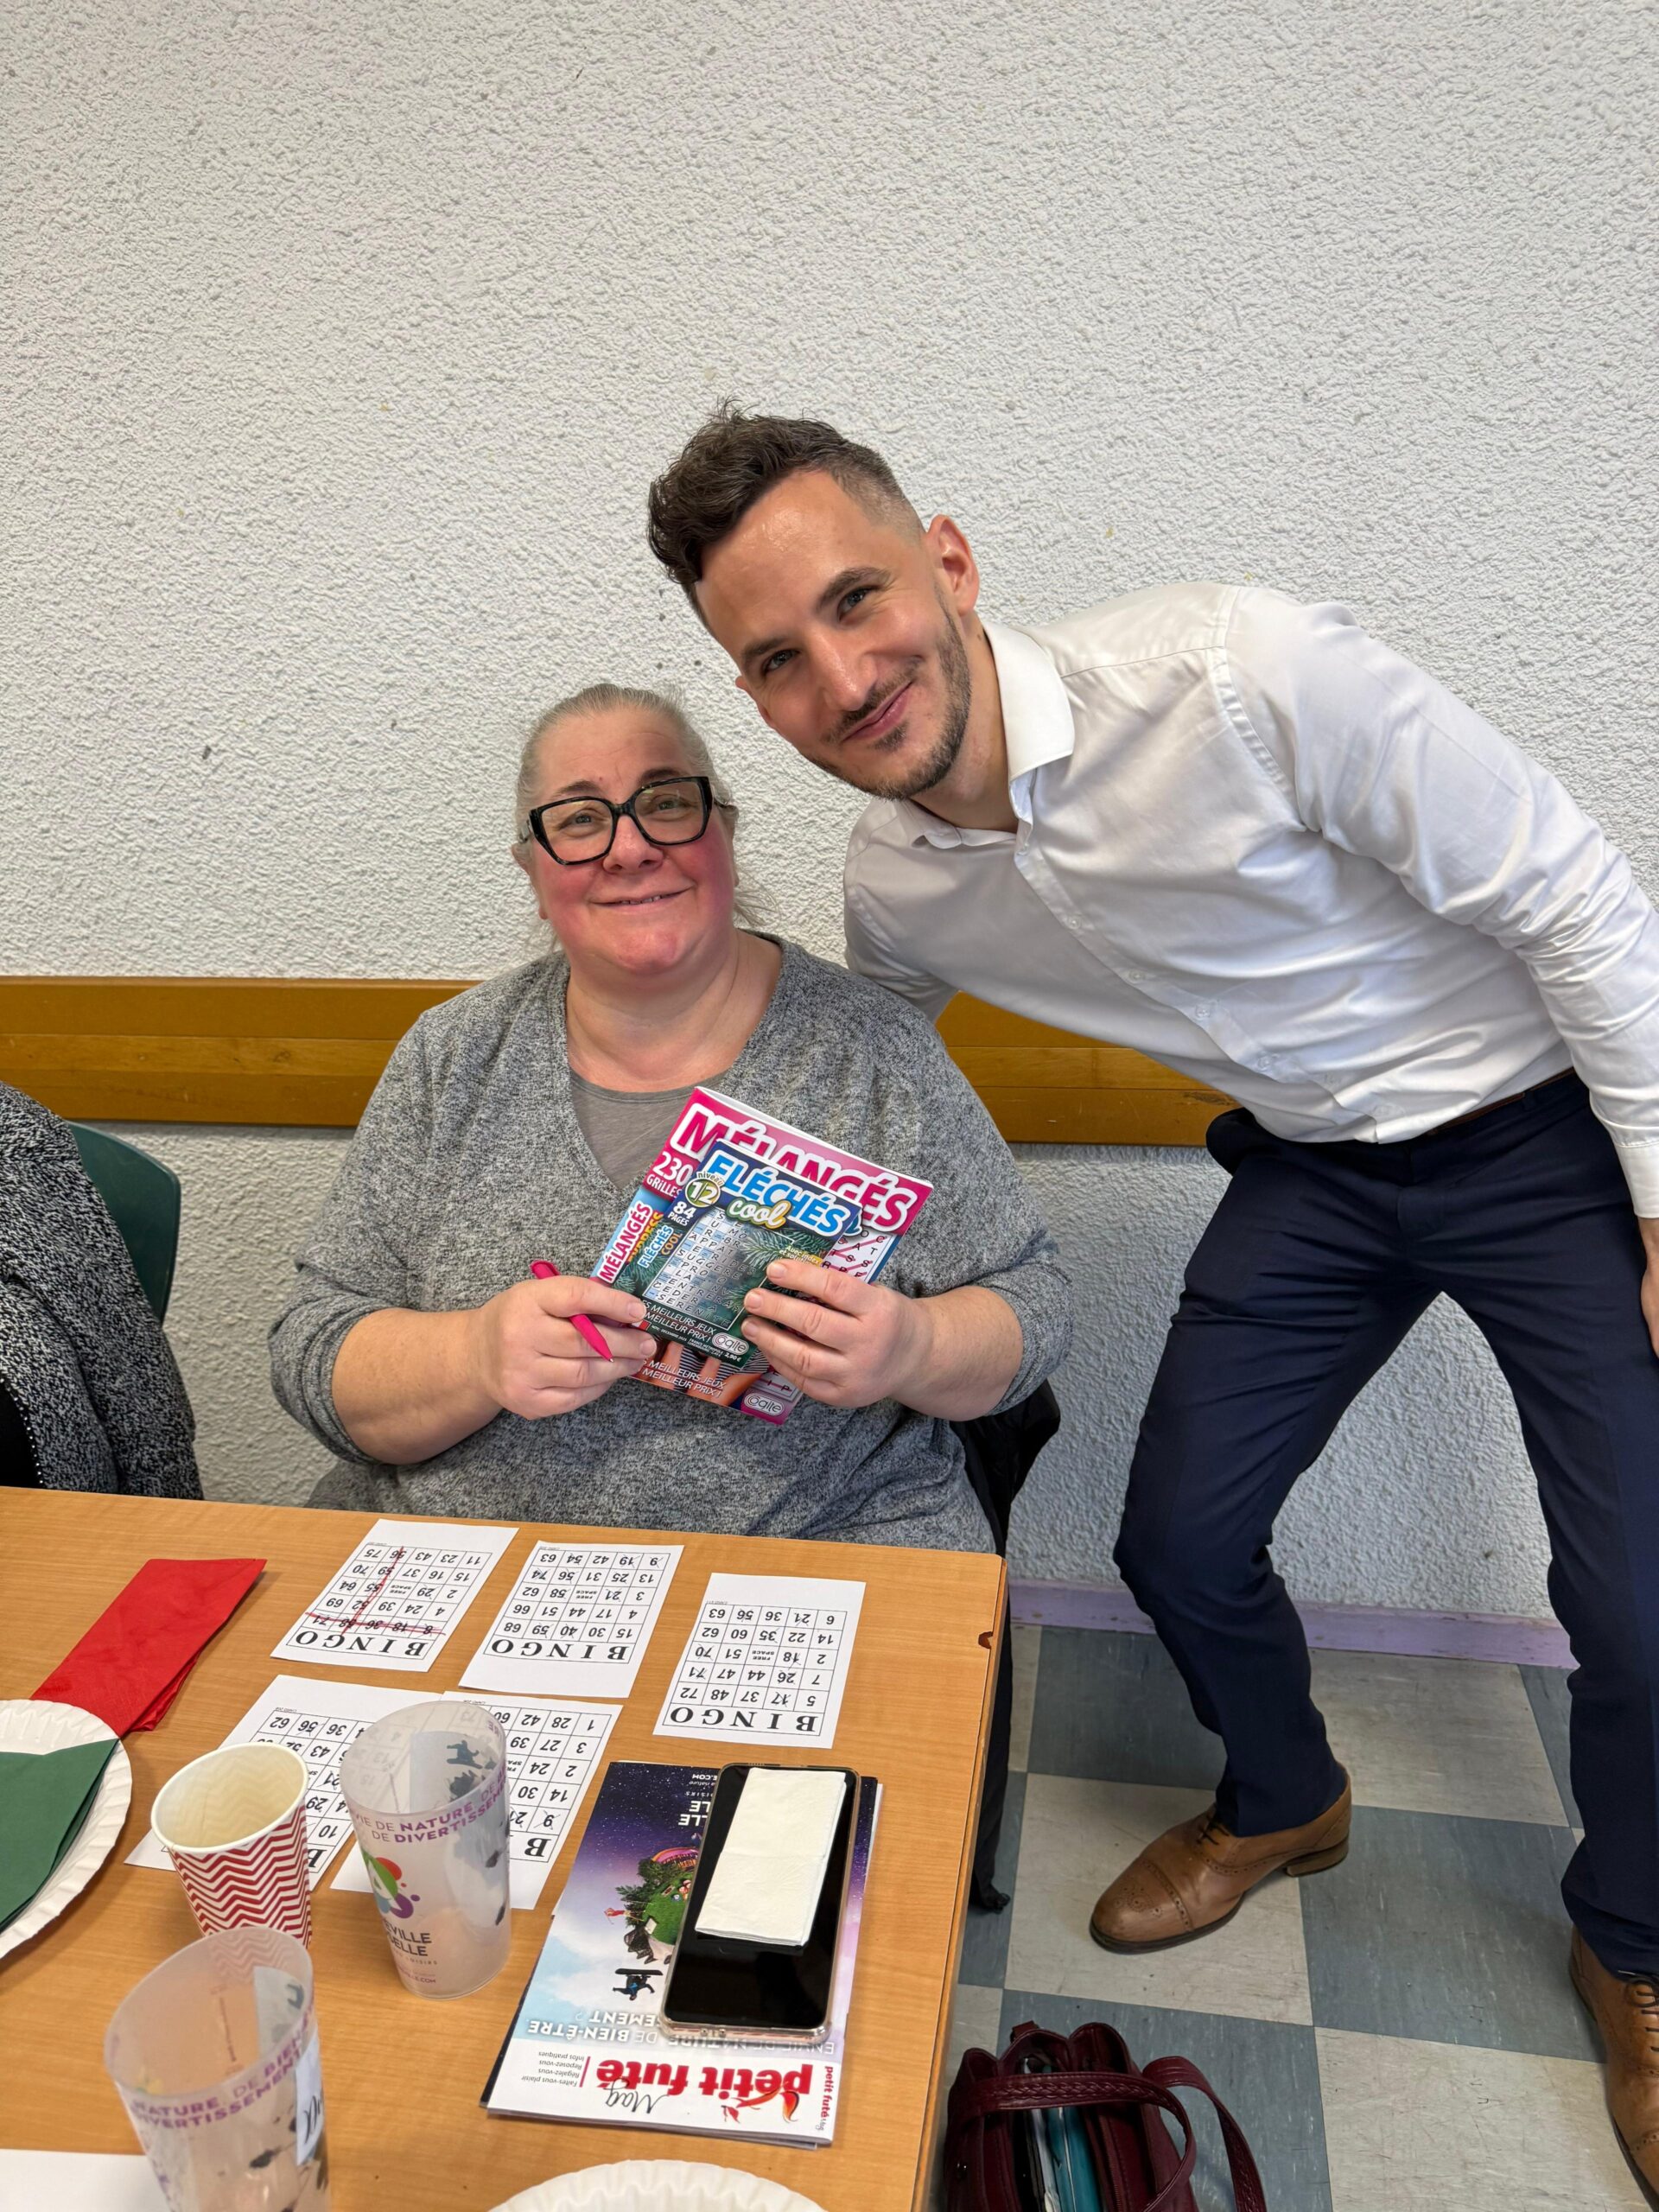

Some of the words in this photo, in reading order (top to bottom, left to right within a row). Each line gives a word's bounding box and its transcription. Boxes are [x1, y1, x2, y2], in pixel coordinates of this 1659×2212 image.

[652, 1151, 693, 1186] 230
[697, 1172, 724, 1186] niveau
[709, 1154, 844, 1235] FLÉCHÉS
[673, 1201, 695, 1219] 84
[728, 1200, 791, 1229] cool
[668, 1212, 690, 1226] PAGES
[601, 1204, 652, 1281] MÉLANGÉS
[639, 1226, 673, 1267] FLÉCHÉS
[661, 1233, 682, 1255] COOL
[695, 1323, 716, 1336] JEUX
[701, 1376, 727, 1389] JEUX
[429, 1571, 443, 1580] 16
[454, 1573, 469, 1581] 15
[532, 1571, 548, 1580] 74
[586, 1573, 601, 1581] 31
[639, 1574, 653, 1583] 13
[448, 1590, 457, 1599] 2
[523, 1587, 539, 1596] 62
[550, 1589, 566, 1598] 58
[636, 1592, 645, 1600] 3
[327, 1599, 343, 1607] 69
[378, 1602, 396, 1611] 39
[405, 1605, 423, 1614] 24
[513, 1605, 530, 1614] 66
[543, 1607, 558, 1616] 51
[569, 1608, 586, 1617] 44
[596, 1609, 611, 1618] 17
[709, 1609, 725, 1618] 63
[629, 1611, 637, 1619] 4
[738, 1611, 753, 1619] 56
[766, 1611, 781, 1621] 36
[795, 1614, 810, 1623] 21
[827, 1616, 834, 1624] 6
[505, 1623, 521, 1632] 68
[532, 1624, 549, 1634] 59
[560, 1626, 575, 1635] 40
[589, 1628, 606, 1637] 30
[702, 1628, 719, 1637] 62
[617, 1629, 632, 1638] 15
[731, 1630, 747, 1639] 60
[760, 1631, 776, 1640] 35
[789, 1632, 805, 1643] 22
[818, 1635, 833, 1644] 14
[696, 1647, 712, 1657] 70
[726, 1649, 741, 1659] 51
[783, 1652, 800, 1662] 18
[817, 1655, 826, 1664] 2
[688, 1668, 705, 1677] 71
[717, 1669, 735, 1679] 47
[748, 1670, 766, 1681] 44
[778, 1673, 795, 1682] 26
[812, 1675, 819, 1685] 7
[681, 1688, 697, 1699] 72
[711, 1690, 729, 1700] 48
[741, 1692, 759, 1702] 37
[772, 1694, 789, 1704] 17
[807, 1696, 816, 1706] 5
[270, 1717, 290, 1729] 62
[521, 1714, 541, 1726] 42
[551, 1717, 571, 1729] 28
[587, 1719, 595, 1731] 1
[297, 1719, 318, 1732] 56
[327, 1723, 346, 1735] 36
[510, 1736, 531, 1749] 39
[540, 1738, 561, 1751] 27
[577, 1742, 587, 1753] 3
[310, 1745, 330, 1759] 43
[531, 1762, 550, 1775] 24
[566, 1765, 577, 1777] 2
[518, 1785, 538, 1799] 30
[550, 1789, 569, 1802] 14
[307, 1796, 328, 1813] 29
[400, 1802, 474, 1832] NATURE
[543, 1815, 554, 1828] 9
[318, 1824, 338, 1839] 10
[372, 1830, 391, 1842] DE
[636, 2031, 657, 2044] DE
[539, 2060, 582, 2070] Reposez-vous
[537, 2069, 580, 2078] Régalez-vous
[596, 2060, 690, 2096] futé
[542, 2077, 577, 2087] Faites-vous
[698, 2064, 813, 2100] petit
[824, 2066, 834, 2094] petit
[603, 2078, 668, 2114] Mag
[820, 2094, 831, 2118] futé
